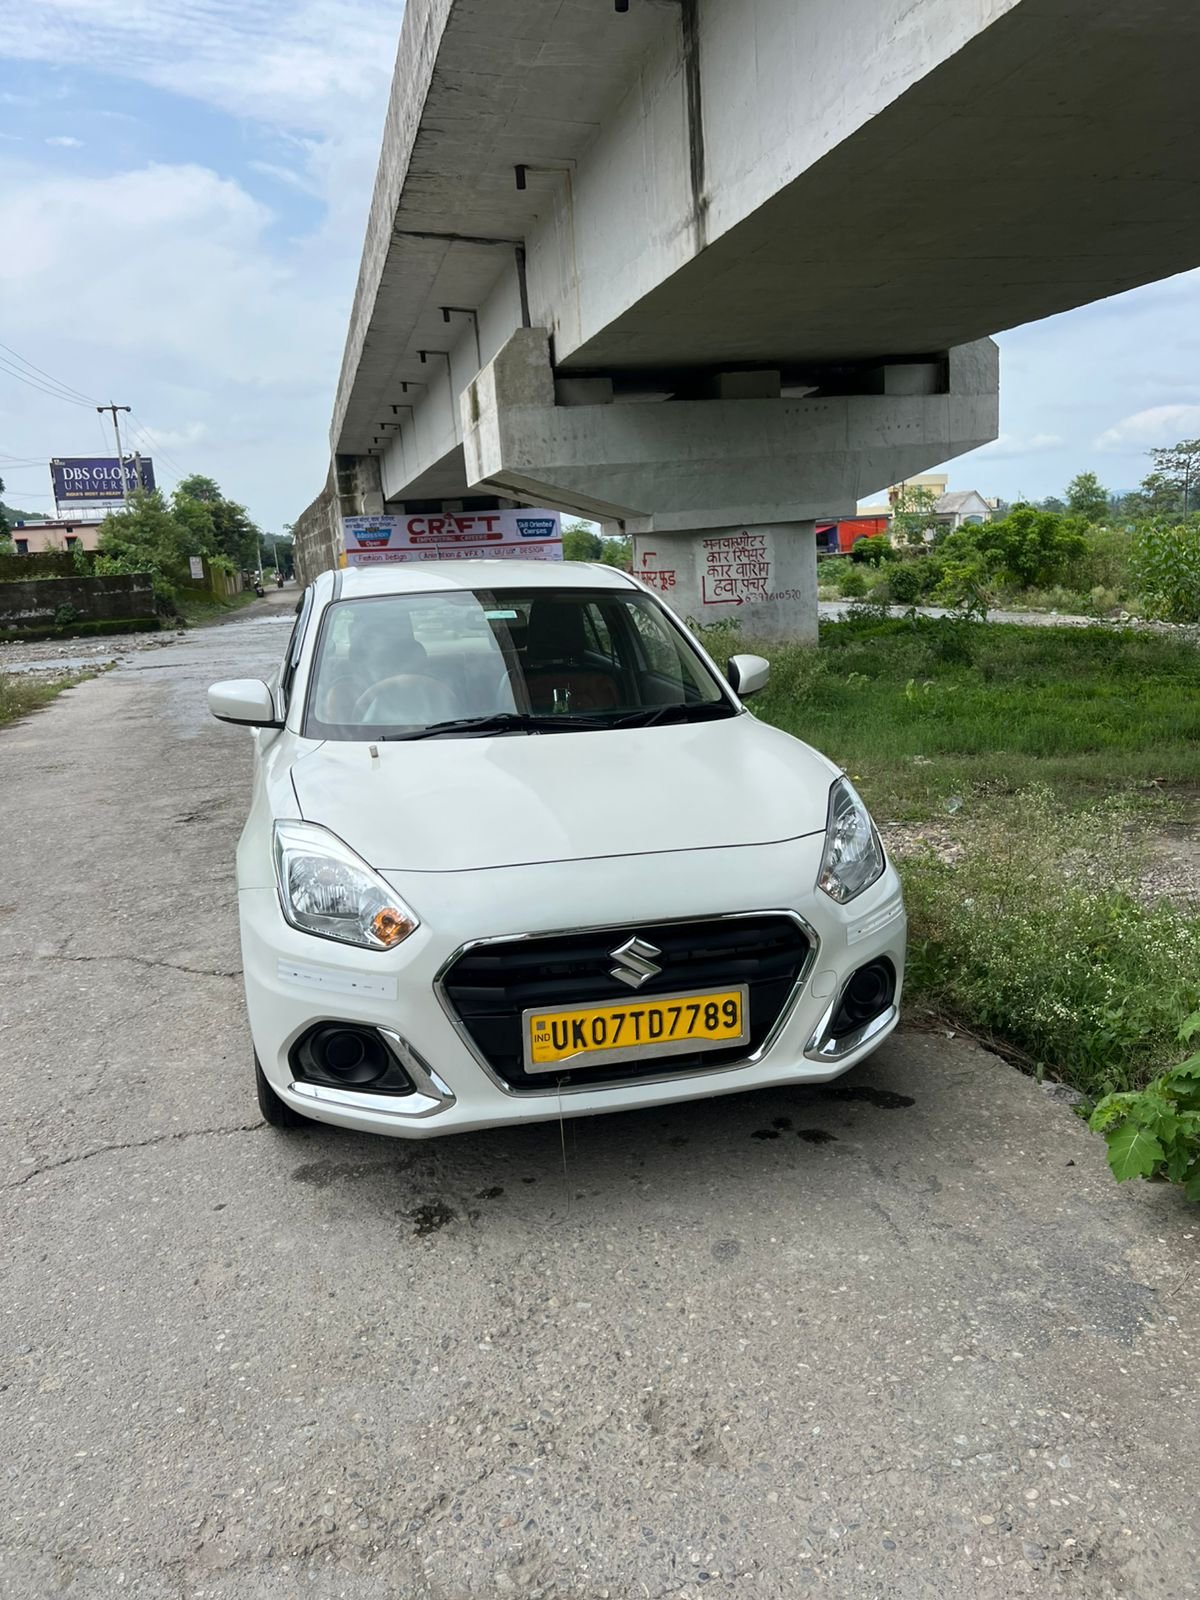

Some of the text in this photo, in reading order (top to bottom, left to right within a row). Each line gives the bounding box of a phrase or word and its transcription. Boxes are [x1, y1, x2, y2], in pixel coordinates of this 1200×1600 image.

[63, 467, 148, 480] DBS GLOBA
[64, 479, 150, 490] UNIVERSIT
[407, 513, 501, 535] CRAFT
[519, 546, 545, 554] DESIGN
[706, 551, 730, 564] कार
[706, 564, 733, 578] कार
[534, 1000, 738, 1051] IND UK07TD7789
